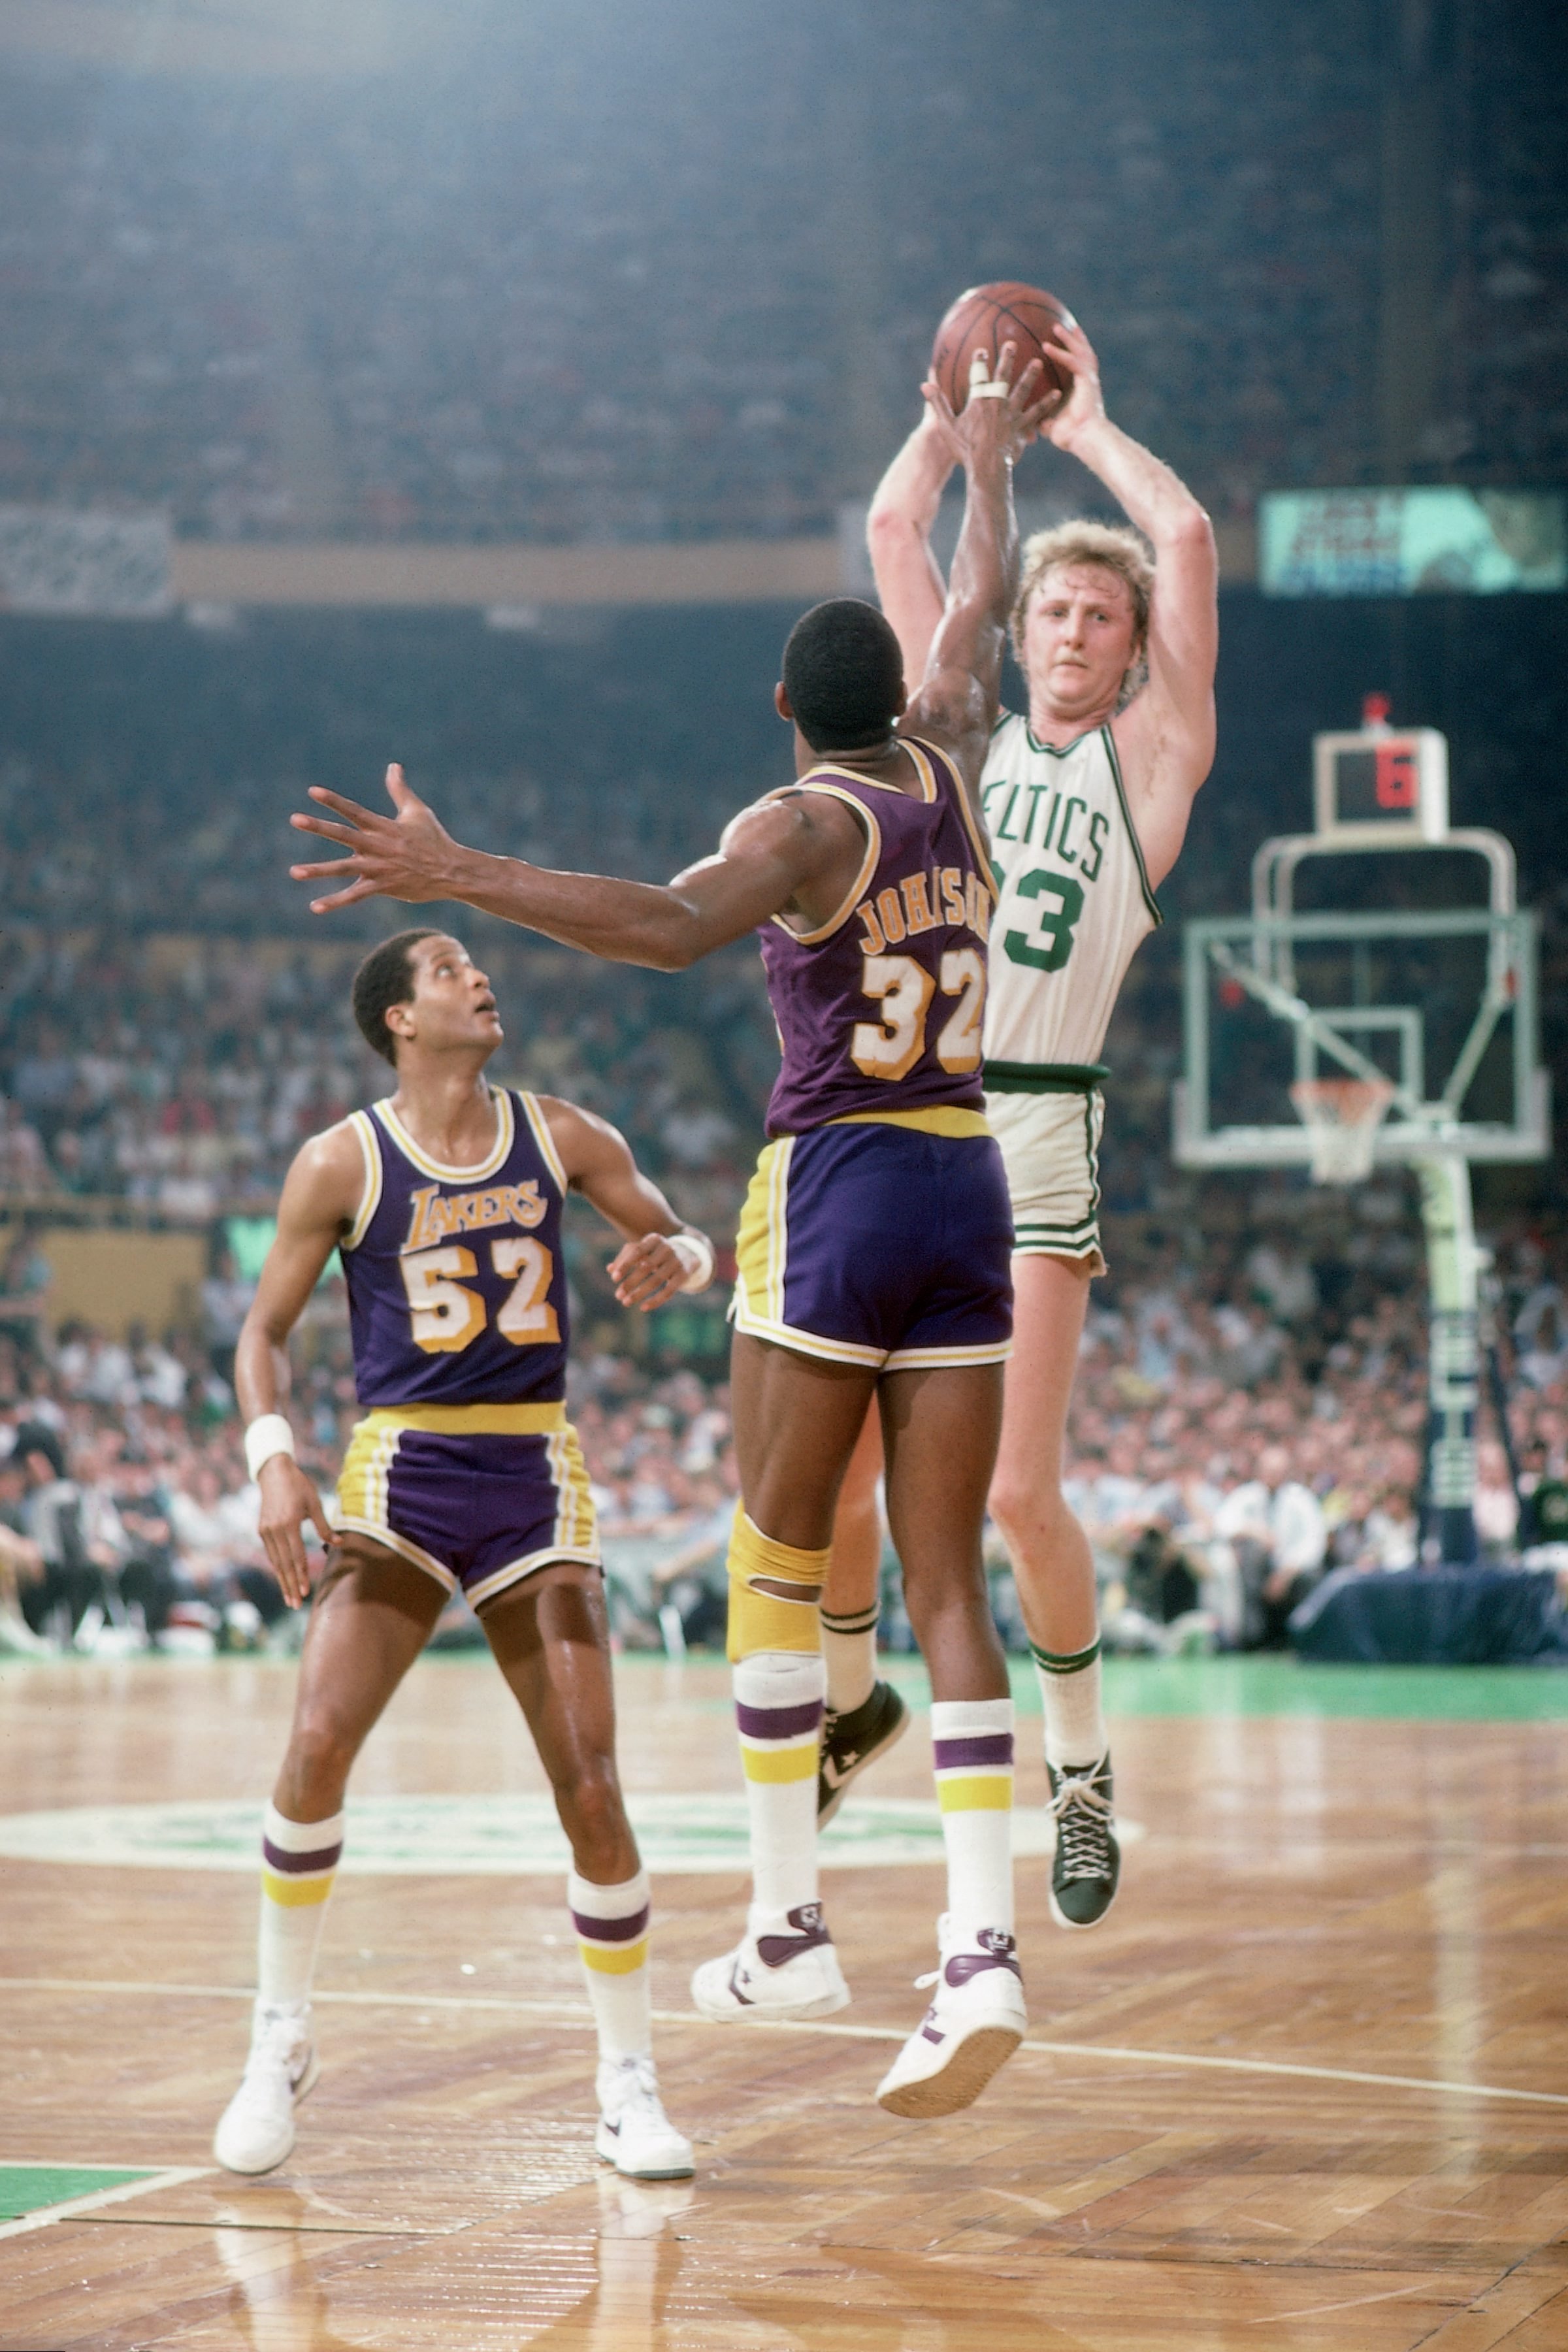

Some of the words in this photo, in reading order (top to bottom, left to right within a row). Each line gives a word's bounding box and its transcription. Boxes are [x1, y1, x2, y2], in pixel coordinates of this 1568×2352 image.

[1375, 738, 1420, 808] 6
[982, 780, 1109, 882] ELTICS
[857, 866, 990, 956] JOHSO
[985, 860, 1085, 973] 3
[851, 947, 987, 1082] 32
[400, 1179, 548, 1256] LAKERS
[399, 1235, 562, 1354] 52
